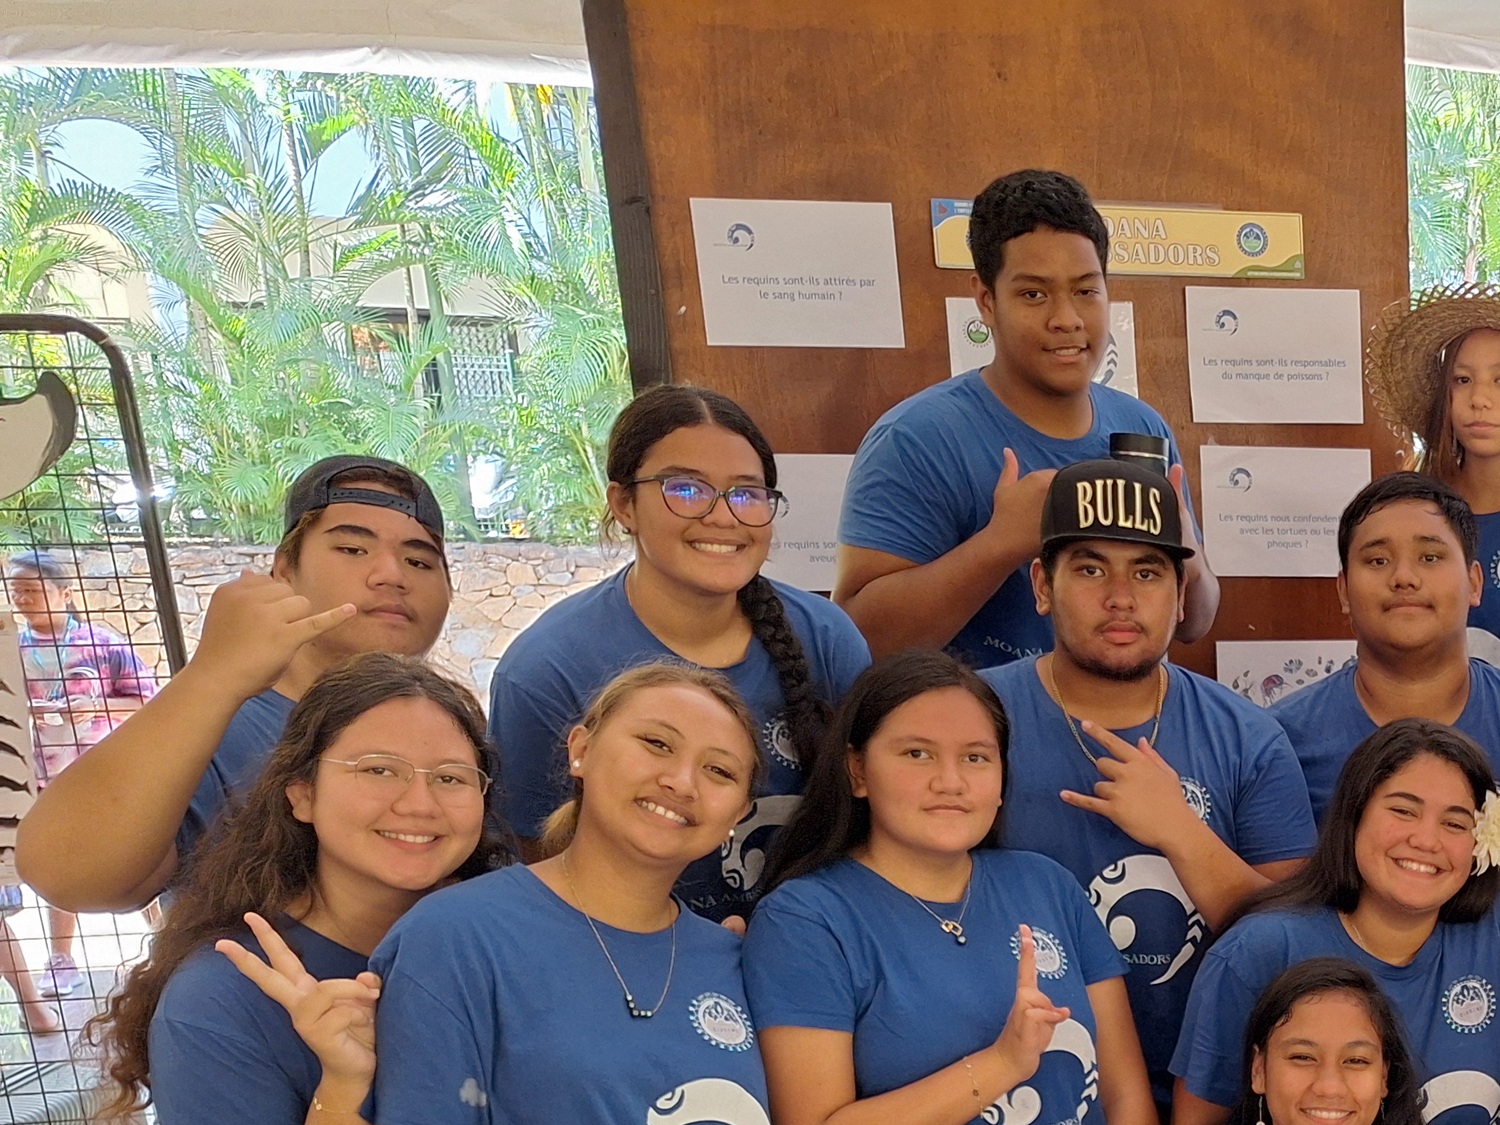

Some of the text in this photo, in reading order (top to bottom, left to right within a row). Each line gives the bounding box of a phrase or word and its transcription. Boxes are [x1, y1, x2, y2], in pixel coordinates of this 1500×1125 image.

[1102, 215, 1168, 240] OANA
[721, 274, 876, 289] Les requins sont-ils attirés par
[759, 289, 769, 299] le
[772, 291, 795, 302] sang
[798, 291, 836, 301] humain
[1203, 357, 1347, 370] Les requins sont-ils responsables
[1222, 371, 1233, 380] du
[1235, 372, 1271, 382] manque
[1273, 371, 1284, 380] de
[1287, 372, 1323, 382] poissons
[1076, 478, 1162, 536] BULLS
[1219, 513, 1234, 522] Les
[1236, 513, 1268, 525] requins
[1270, 515, 1290, 523] nous
[1261, 526, 1274, 535] les
[1277, 527, 1308, 536] tortues
[1310, 528, 1321, 536] ou
[1323, 526, 1336, 536] les
[783, 540, 820, 551] requins
[1267, 539, 1303, 549] phoques
